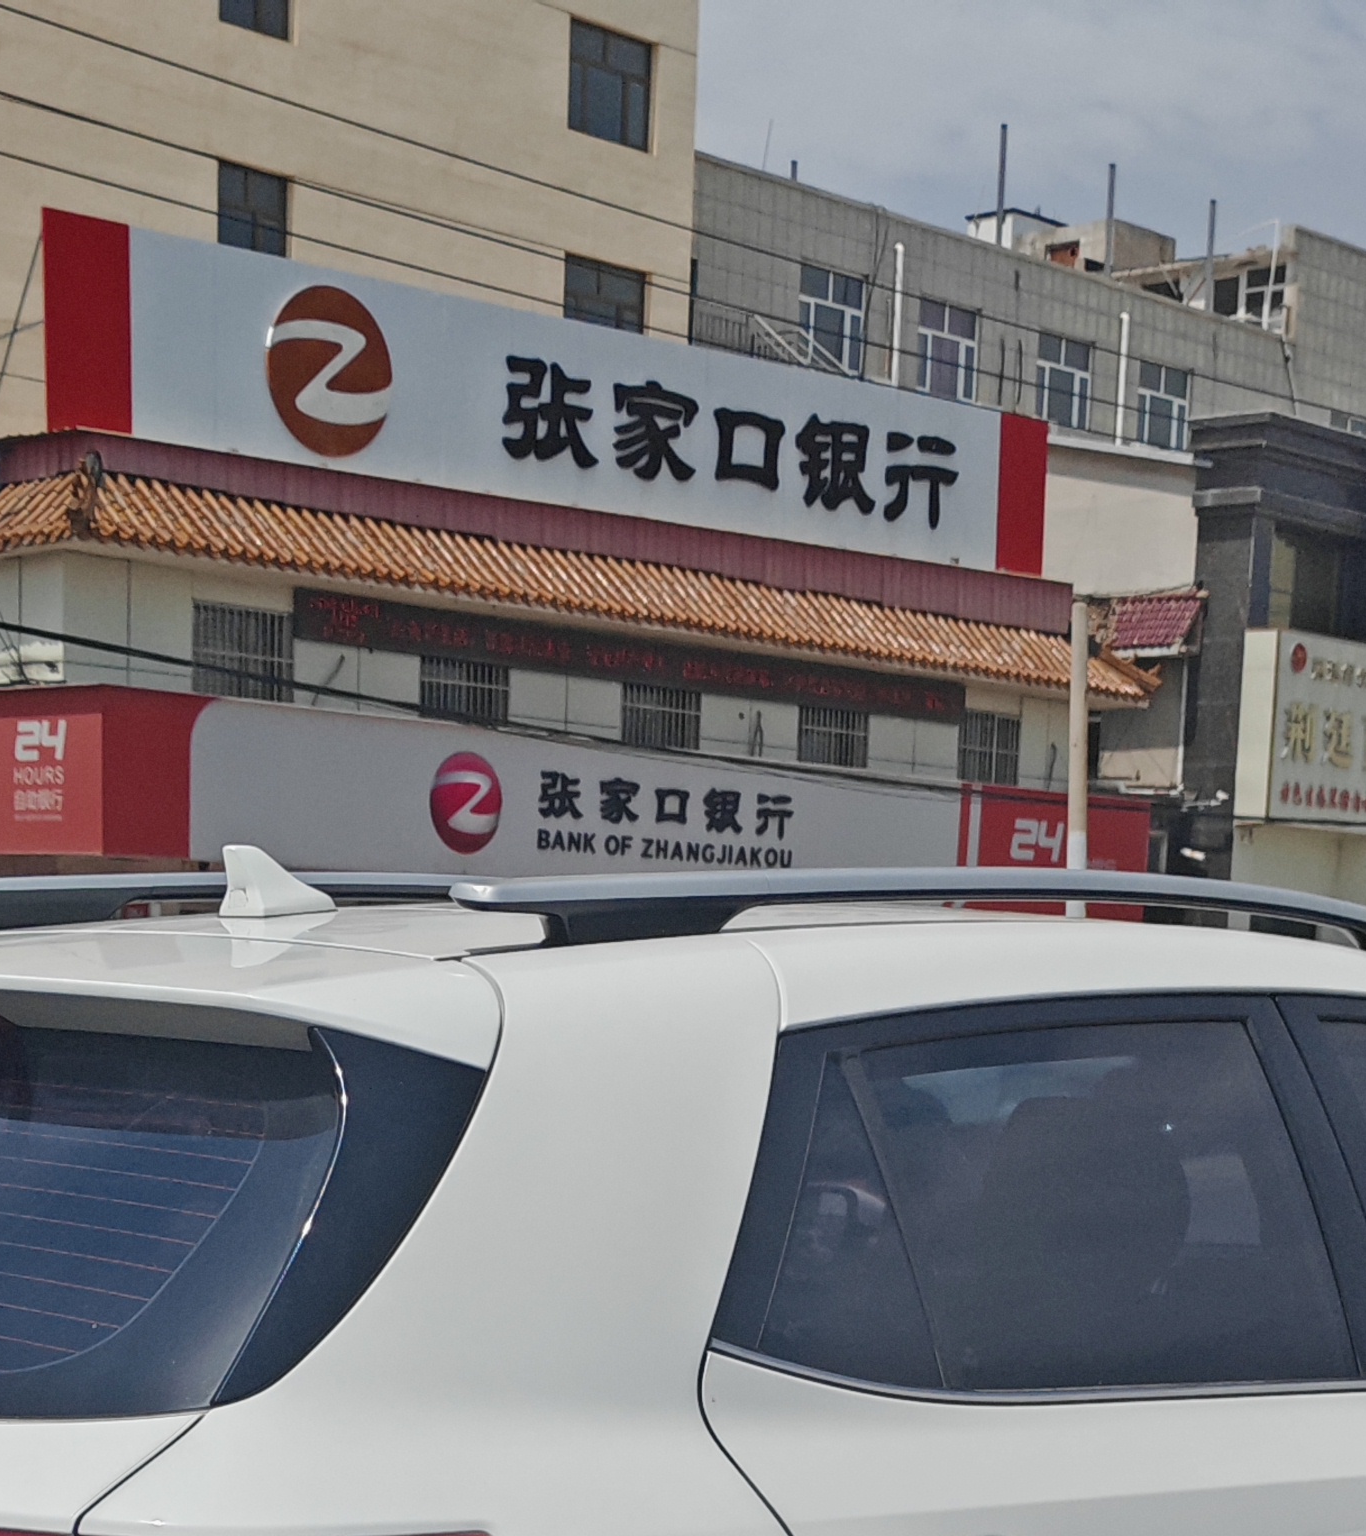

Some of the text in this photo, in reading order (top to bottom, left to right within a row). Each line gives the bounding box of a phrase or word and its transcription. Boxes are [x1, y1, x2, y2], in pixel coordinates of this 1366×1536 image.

[501, 354, 960, 531] 张家口银行
[14, 719, 67, 762] 24
[13, 765, 65, 785] HOURS
[537, 770, 795, 842] 张家口银行
[537, 828, 793, 869] BANK OF ZHANGJIAKOU
[1009, 817, 1066, 864] 24
